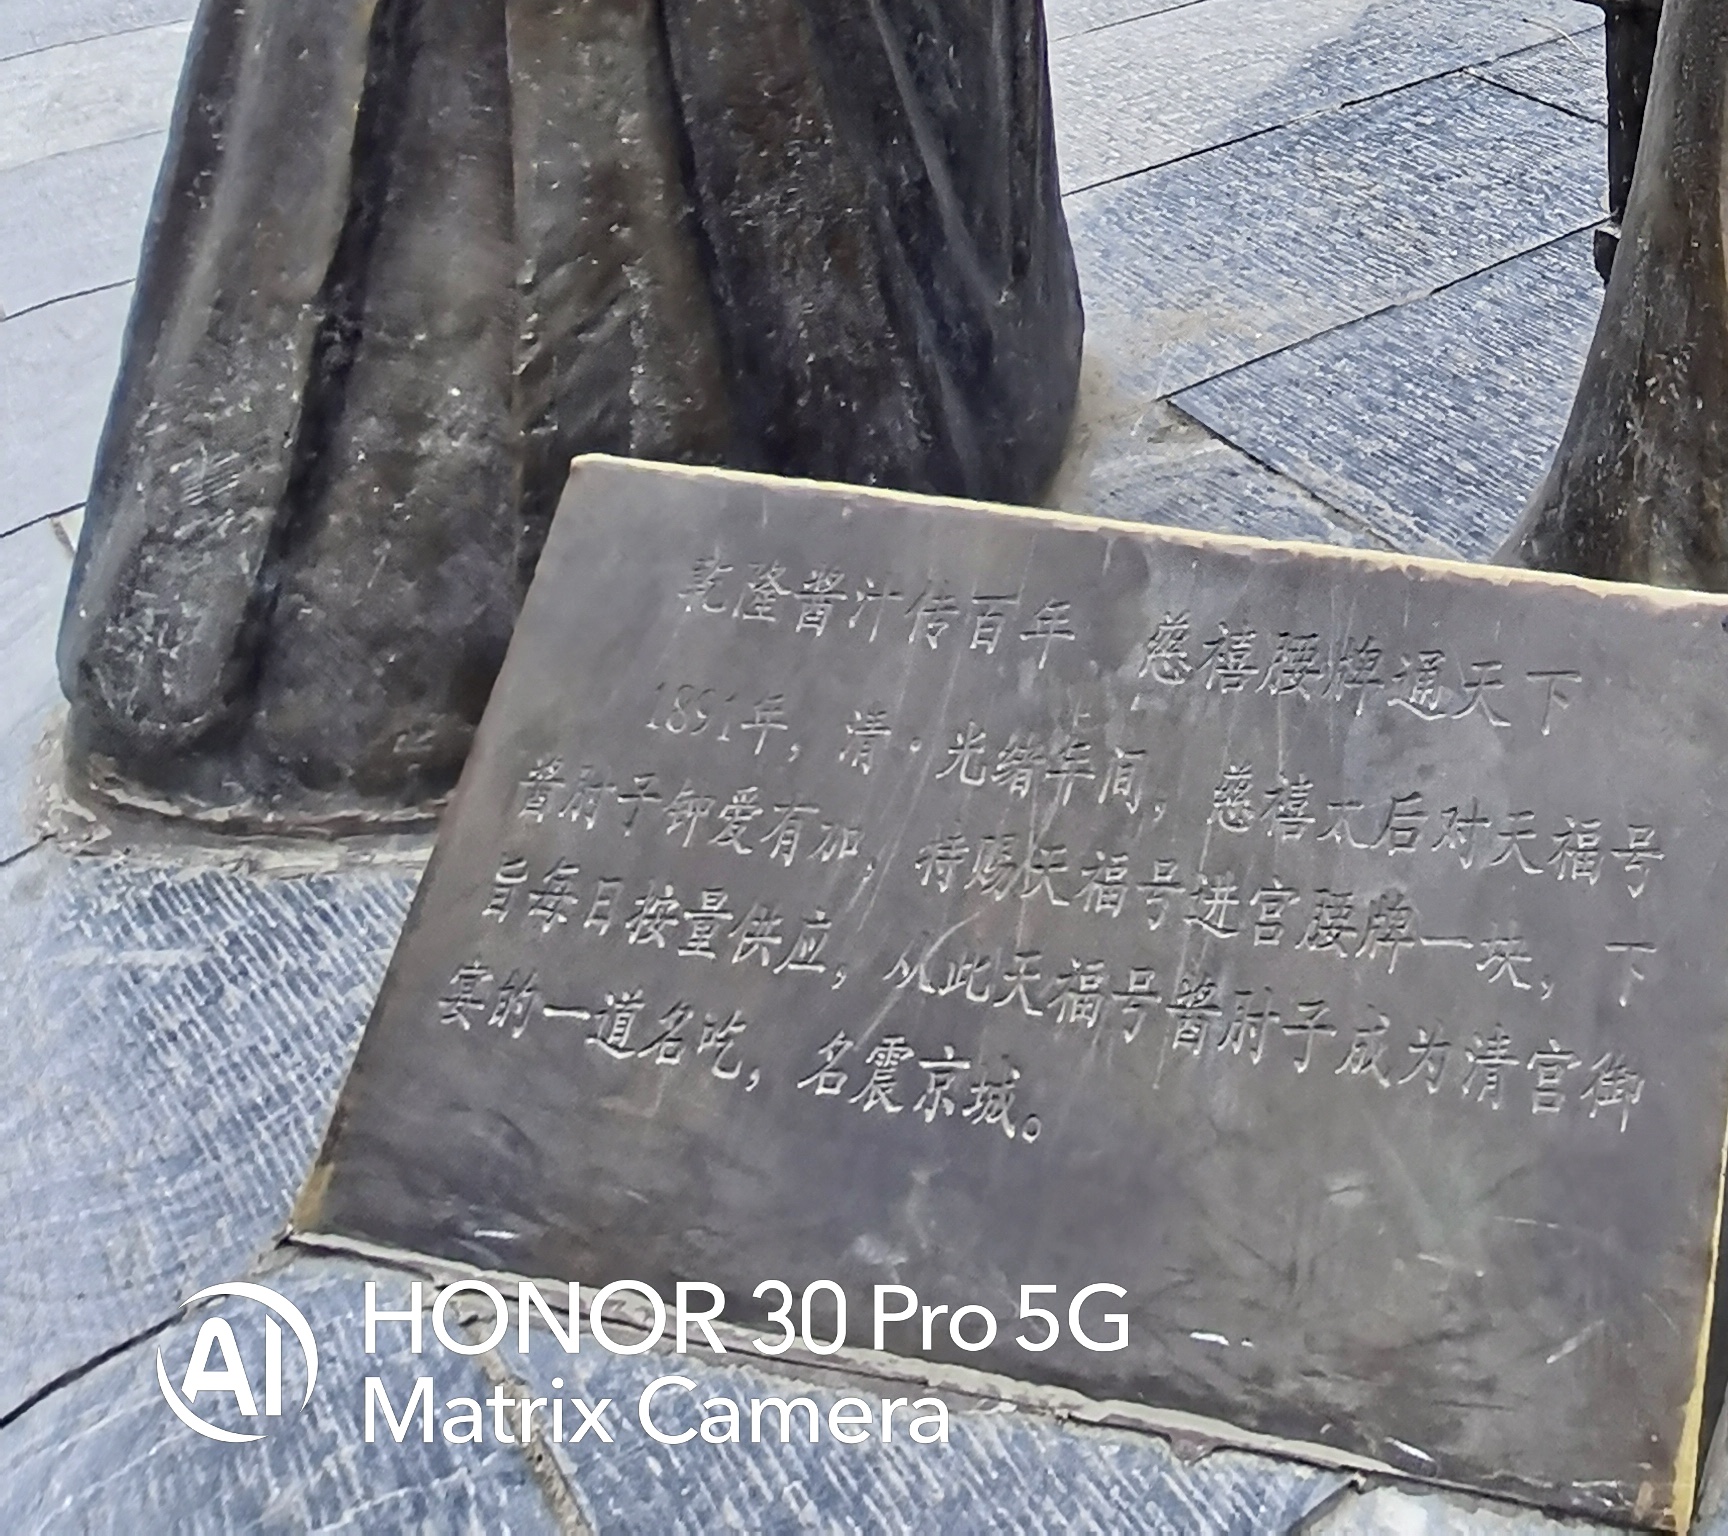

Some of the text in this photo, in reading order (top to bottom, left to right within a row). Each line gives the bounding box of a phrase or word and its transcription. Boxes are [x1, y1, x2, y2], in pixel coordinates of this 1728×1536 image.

[677, 548, 1584, 736] 乾隆酱汁传百年 慈禧腰牌通天下
